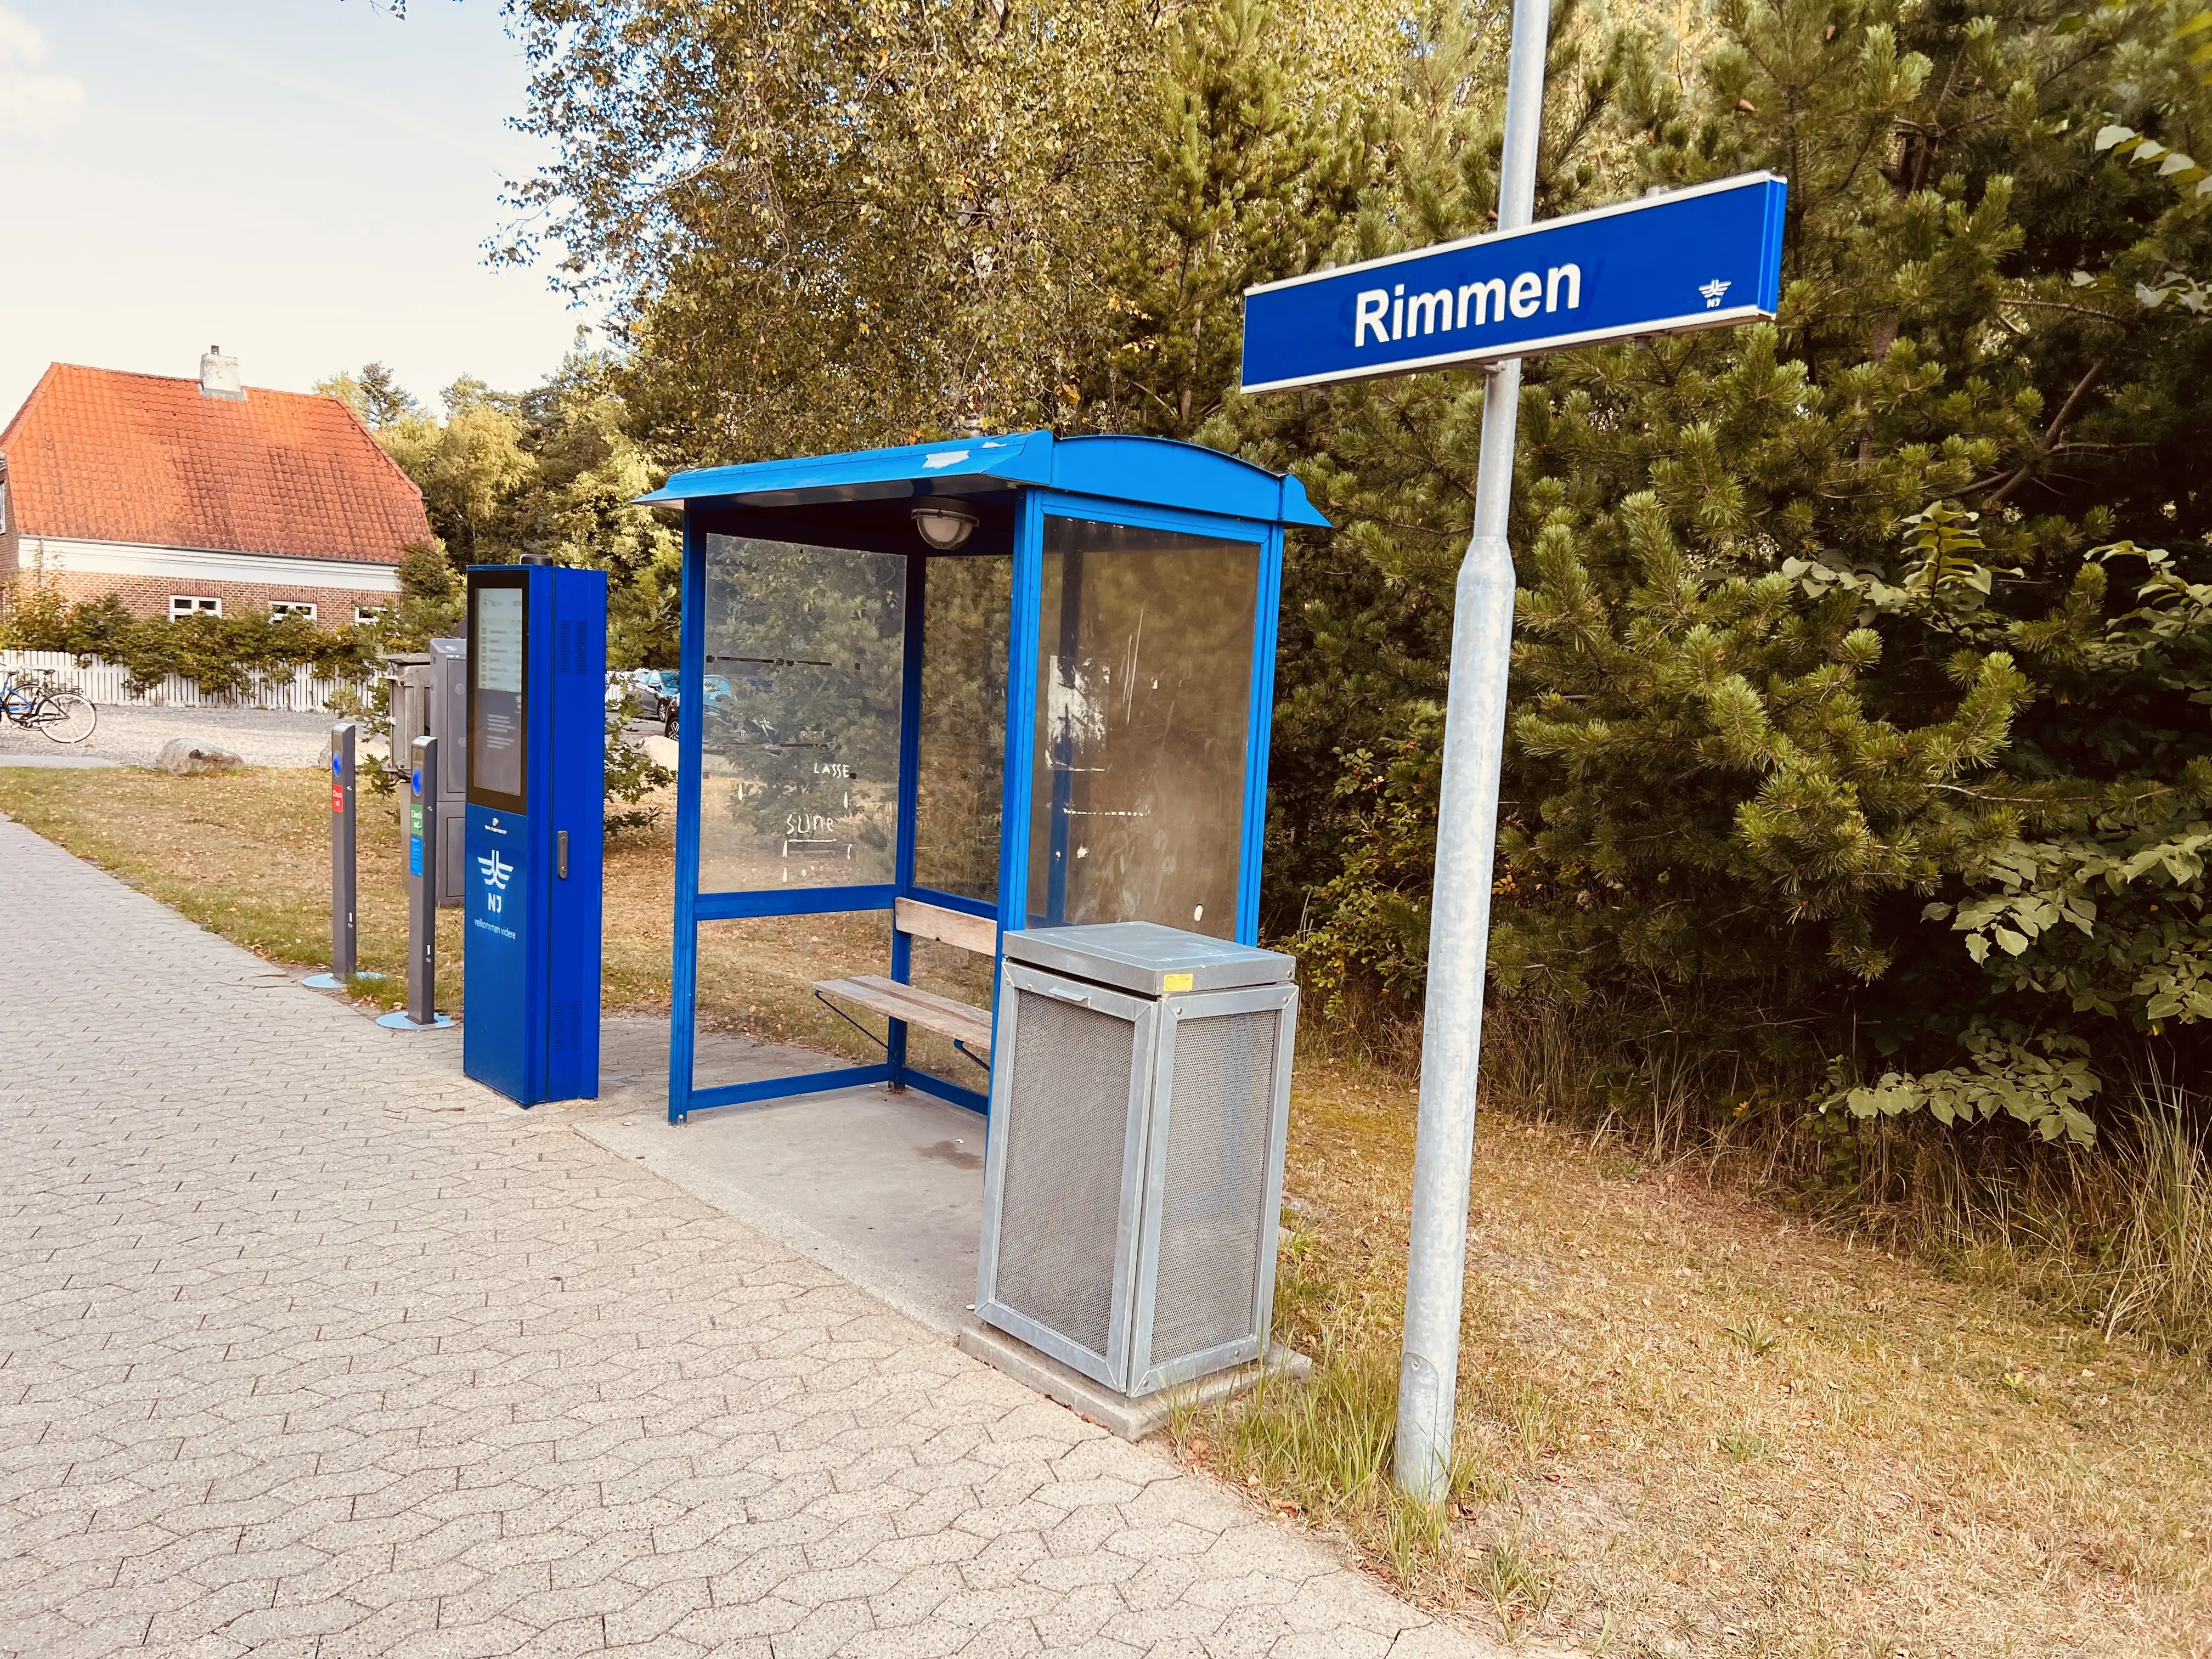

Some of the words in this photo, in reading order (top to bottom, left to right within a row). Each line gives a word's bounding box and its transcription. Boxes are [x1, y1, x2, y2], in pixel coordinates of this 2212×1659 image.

[1355, 263, 1582, 347] Rimmen
[814, 763, 850, 778] LASSE
[411, 810, 422, 819] Check
[488, 893, 501, 913] NJ
[474, 918, 500, 934] velkommen
[500, 926, 516, 939] videre
